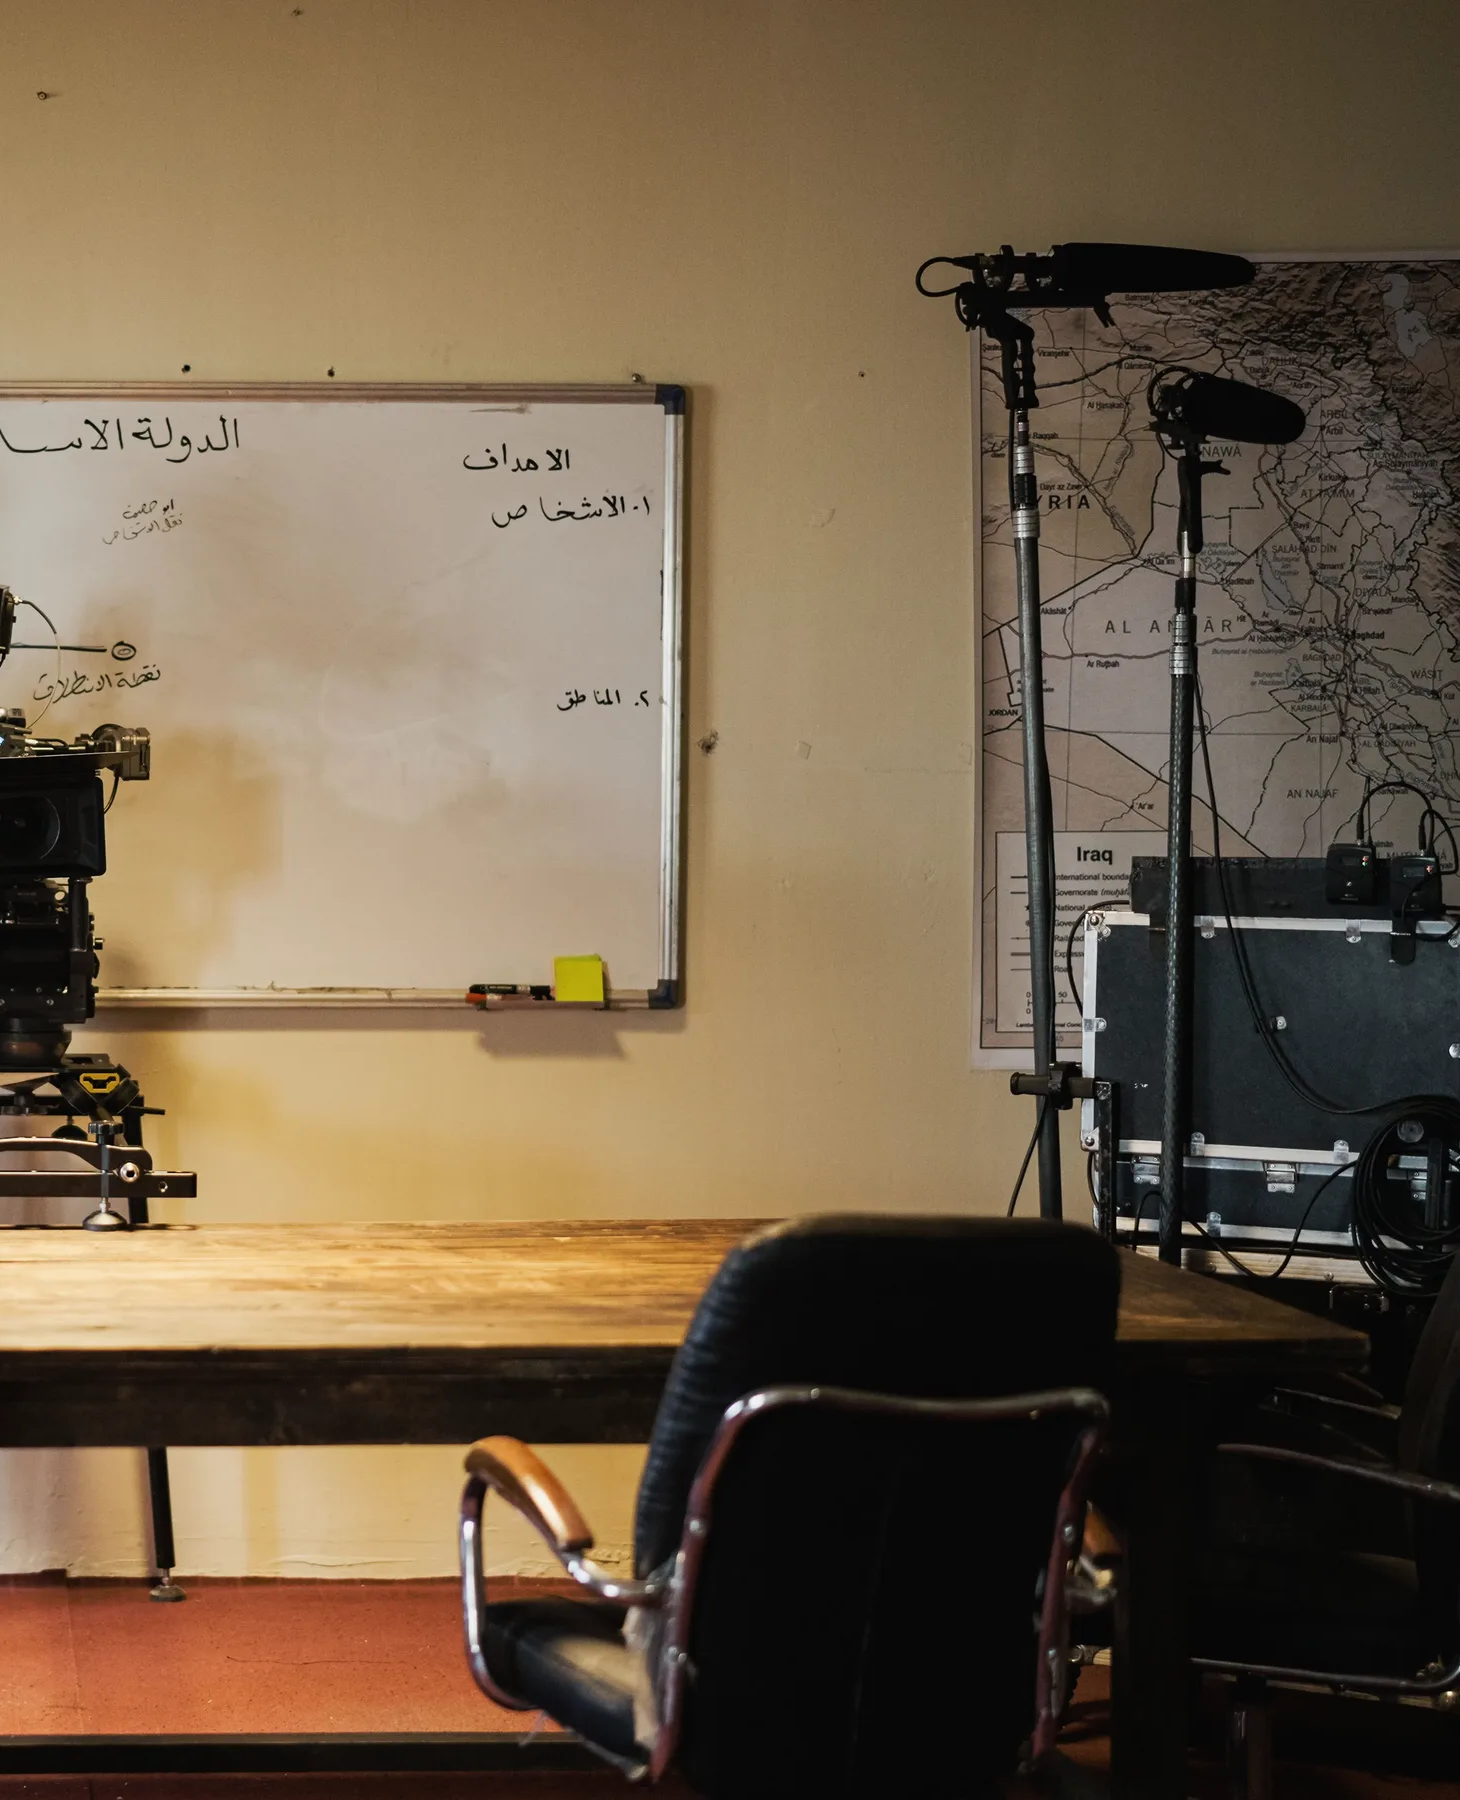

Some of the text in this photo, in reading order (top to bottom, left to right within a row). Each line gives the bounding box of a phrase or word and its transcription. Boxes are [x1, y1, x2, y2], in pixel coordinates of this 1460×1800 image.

[132, 414, 240, 463] الدولة
[462, 442, 571, 473] الاهداف
[1301, 489, 1313, 498] AT
[491, 494, 626, 529] الاشخاص
[1105, 616, 1232, 634] AL ANĀR
[556, 687, 622, 712] المناطق
[1306, 735, 1339, 744] An Najaf
[1287, 789, 1338, 799] AN NAJAF
[1076, 846, 1114, 865] Iraq
